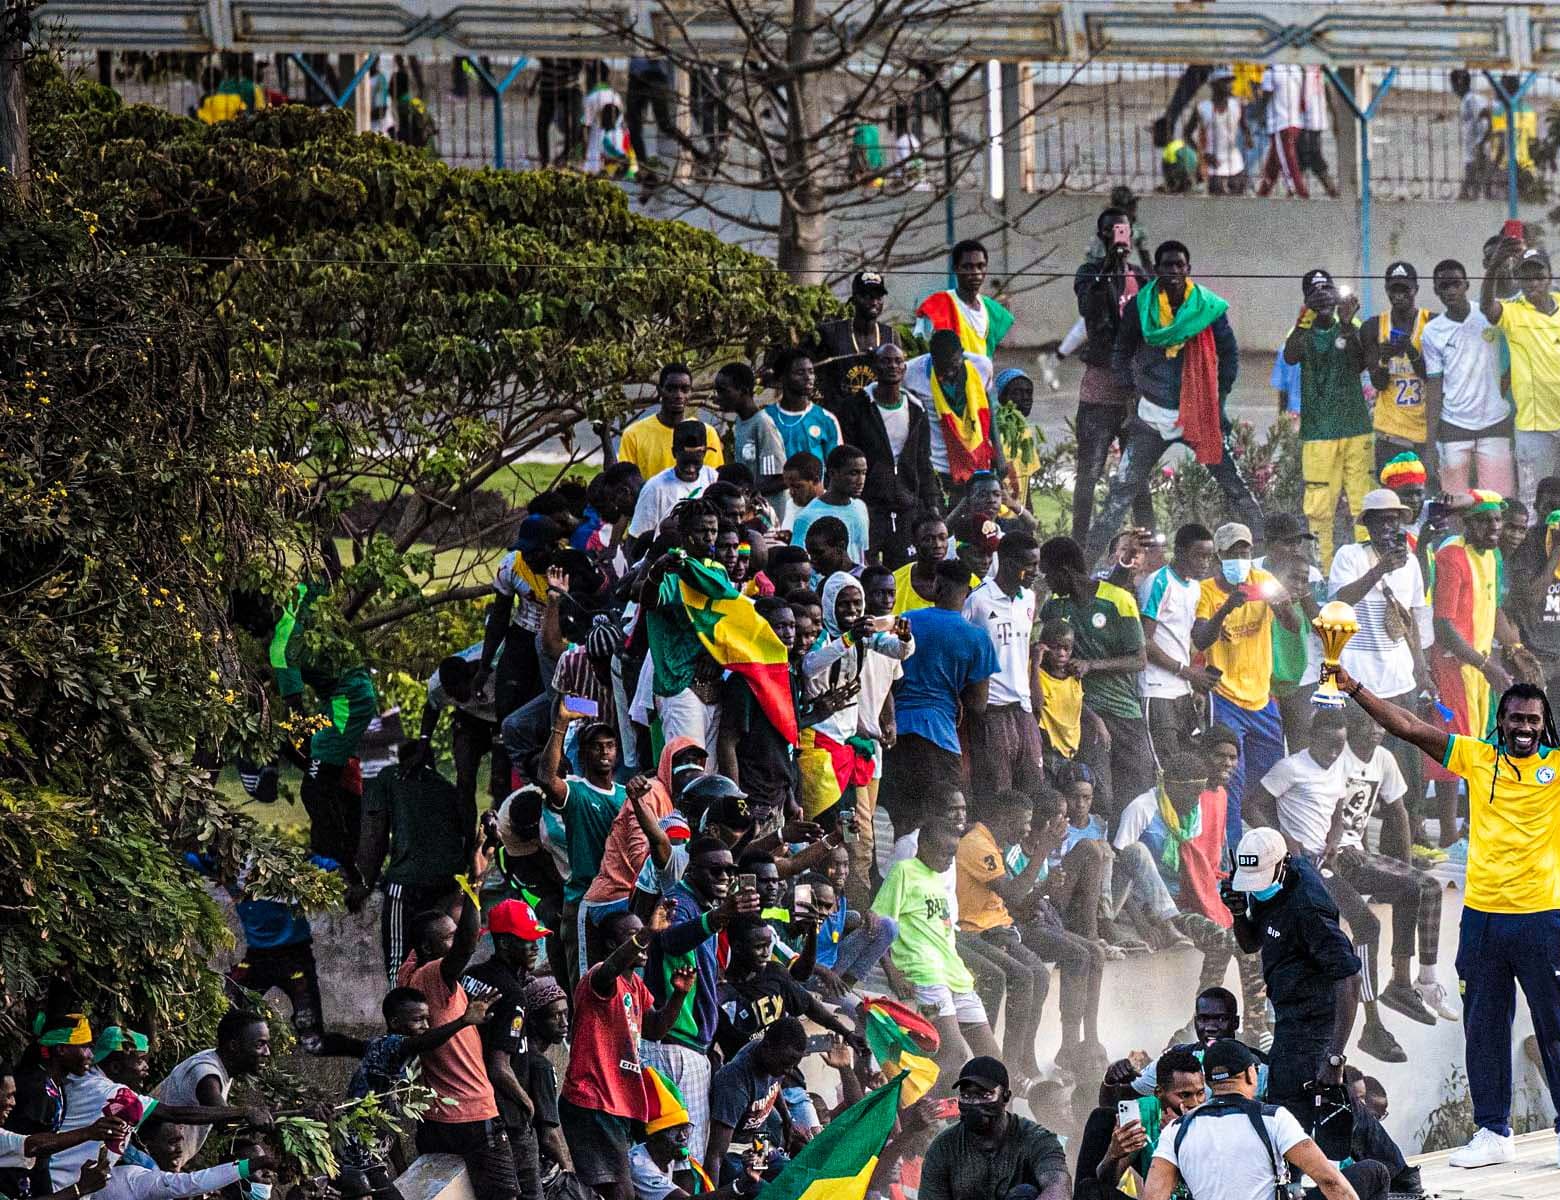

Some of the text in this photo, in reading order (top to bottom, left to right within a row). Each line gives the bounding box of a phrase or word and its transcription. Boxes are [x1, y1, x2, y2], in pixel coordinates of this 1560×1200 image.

[1396, 378, 1421, 406] 23
[1240, 856, 1257, 865] BIP
[1267, 926, 1281, 939] BIP
